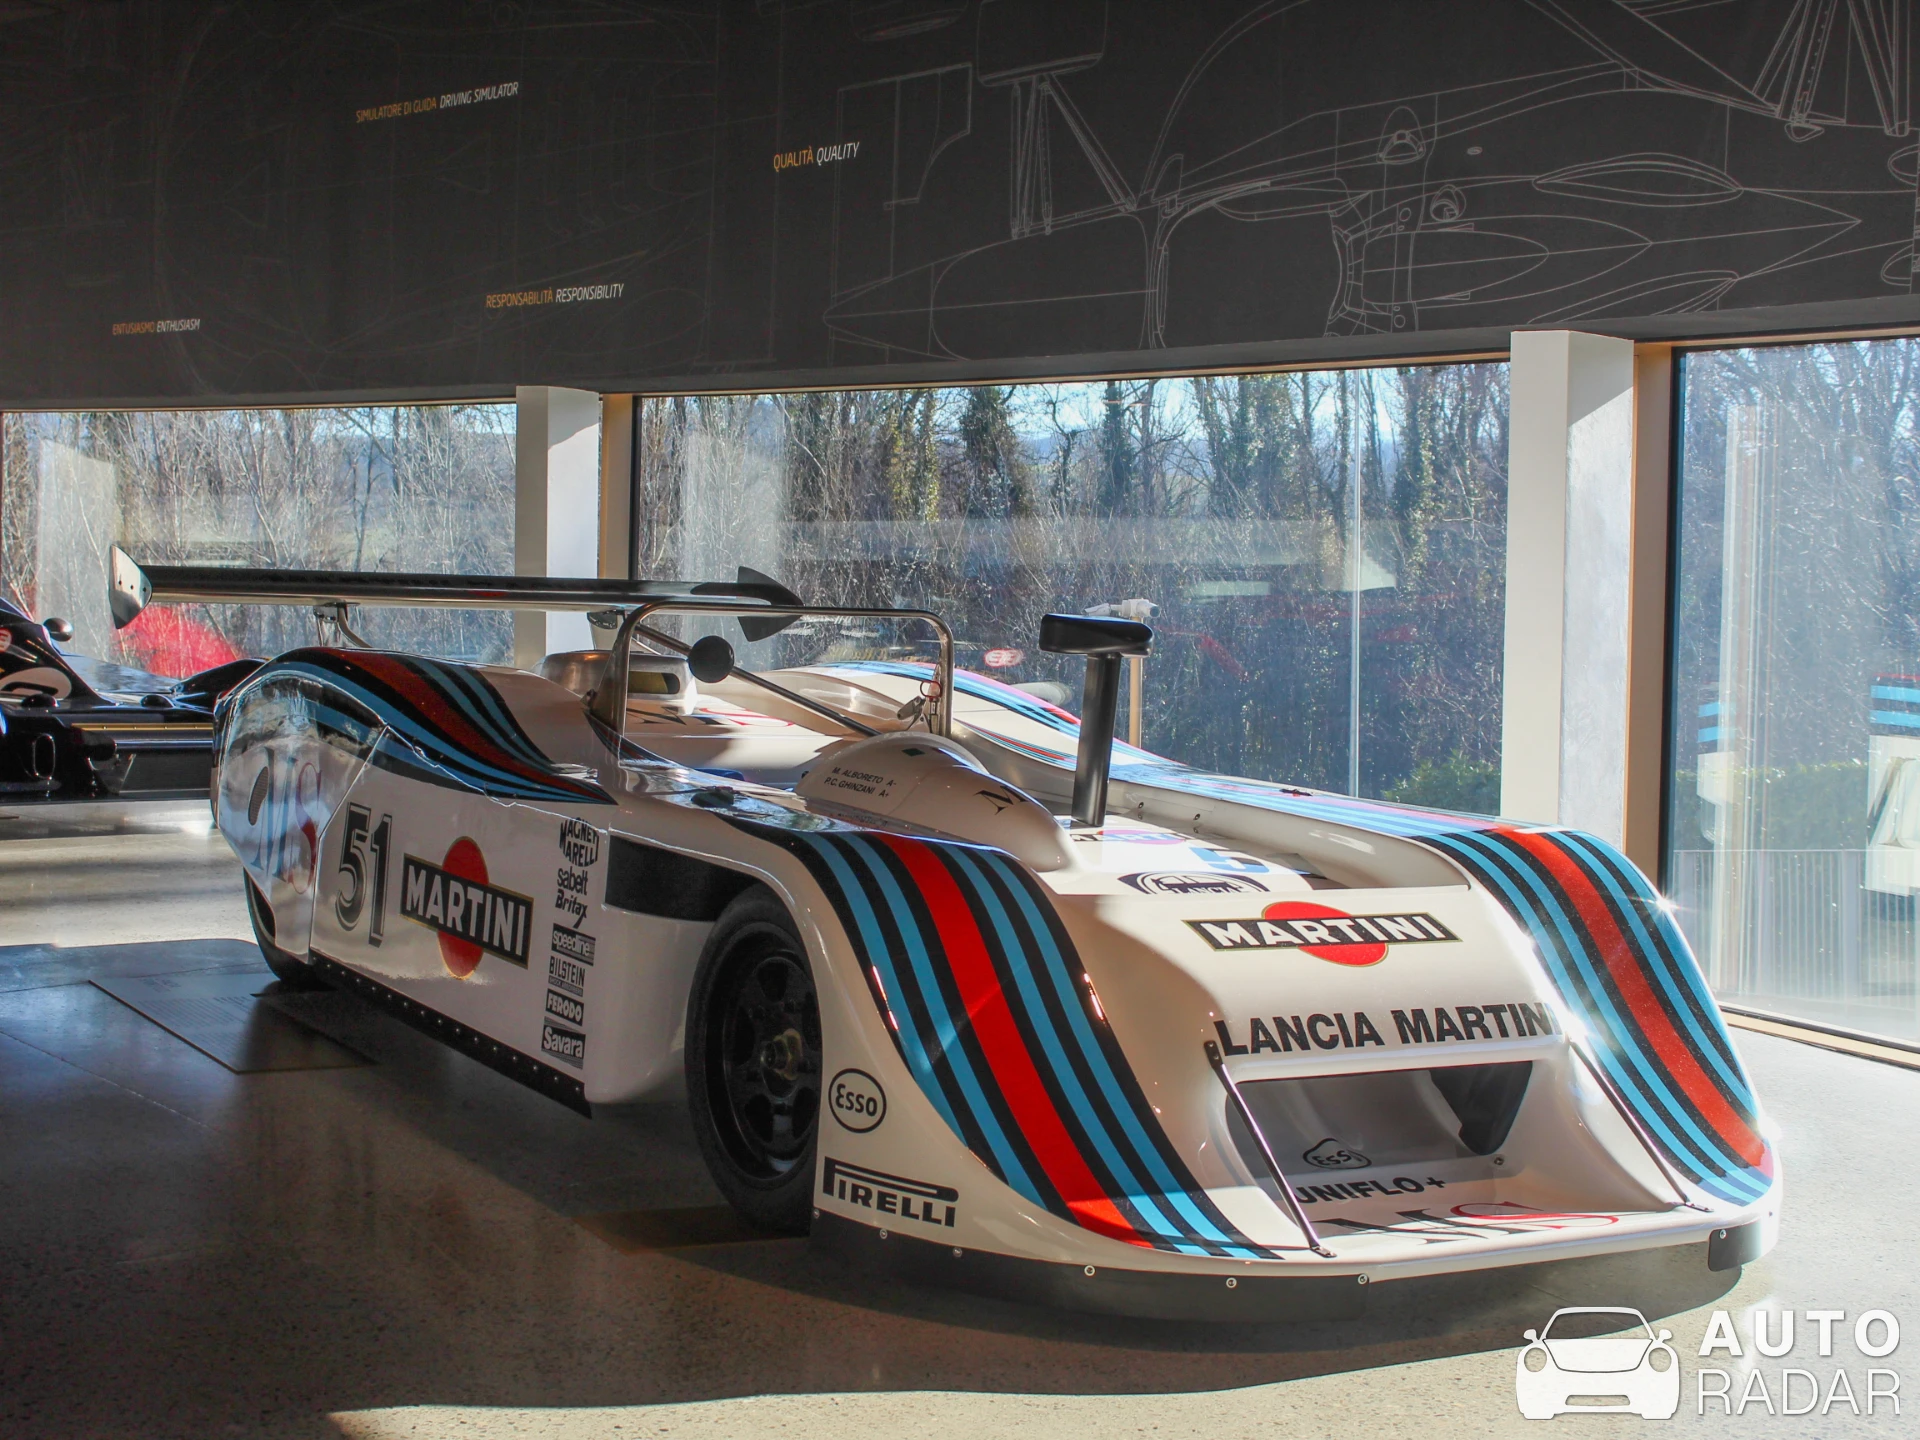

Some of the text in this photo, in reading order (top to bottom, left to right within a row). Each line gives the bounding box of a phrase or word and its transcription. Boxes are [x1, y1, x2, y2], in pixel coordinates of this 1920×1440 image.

[356, 82, 519, 123] SIMULATORE DI GUIDA DRIVING SIMULATOR
[773, 141, 860, 172] QUALITÀ QUALITY
[486, 283, 624, 308] RESPONSABILITÀ RESPONSIBILITY
[112, 319, 200, 336] ENTUSIASMO ENTHUSIASM
[839, 780, 876, 795] GHINZANI
[842, 769, 884, 784] ALBORETO
[334, 802, 392, 948] 51
[556, 866, 588, 896] sabelt
[405, 864, 527, 957] MARTINI
[555, 888, 588, 929] Britax
[552, 930, 591, 958] speedline
[1200, 915, 1446, 947] MARTINI
[549, 955, 586, 988] BILSTEIN
[547, 992, 582, 1023] FERODO
[543, 1026, 583, 1058] Savara
[1213, 1011, 1386, 1057] LANCIA
[822, 1156, 959, 1228] PIRELLI
